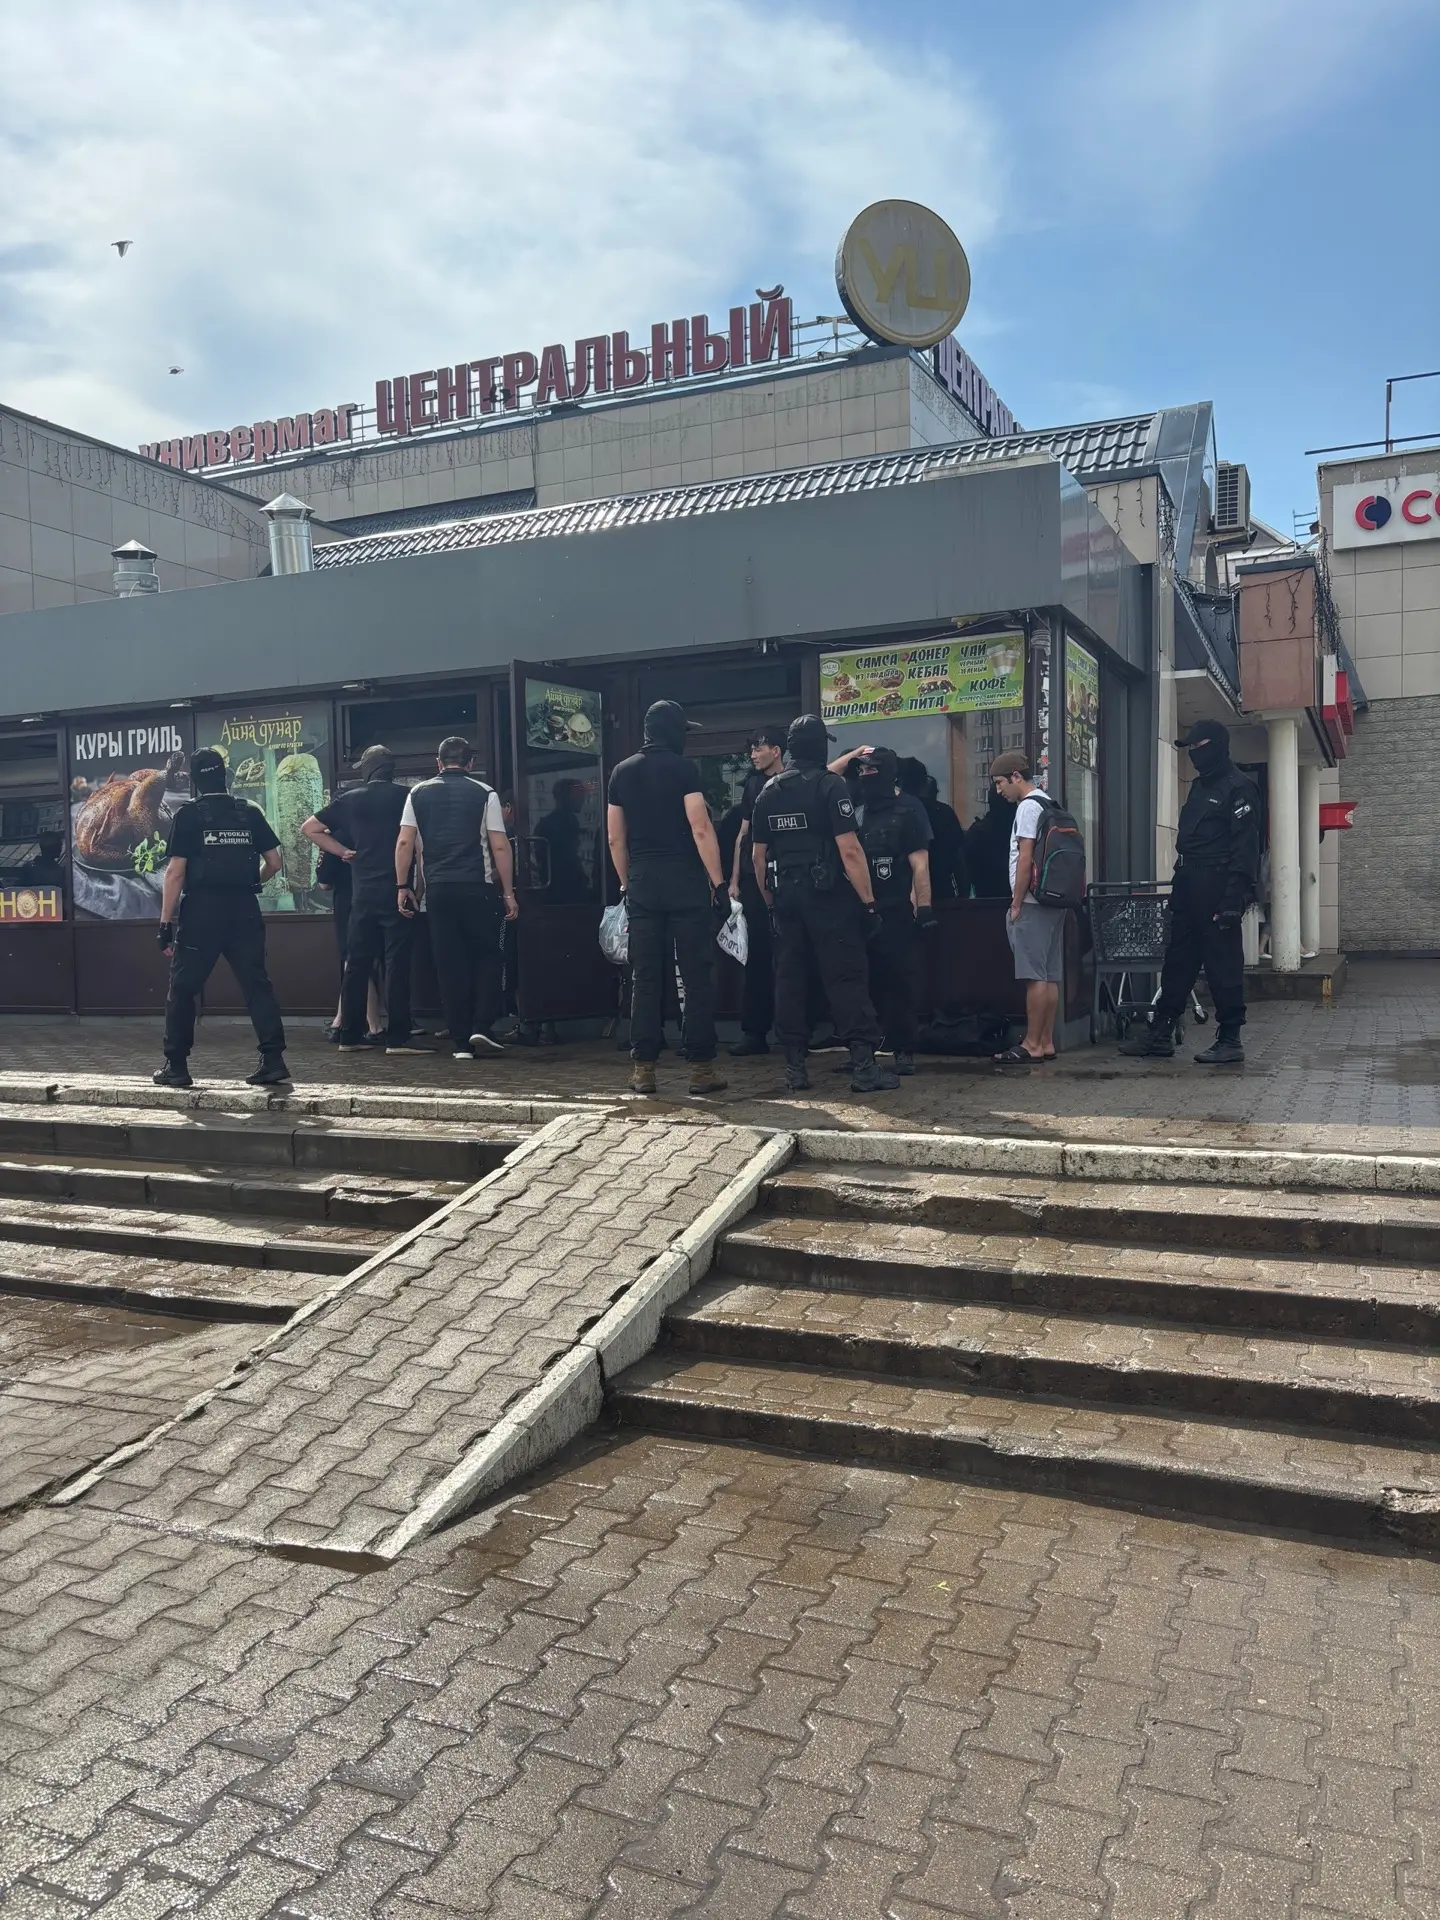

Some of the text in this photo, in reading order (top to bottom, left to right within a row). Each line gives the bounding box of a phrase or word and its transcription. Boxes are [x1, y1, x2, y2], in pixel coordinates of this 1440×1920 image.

[375, 284, 793, 437] ЦЕНТРАЛЬНЫЙ
[855, 653, 898, 669] САМСА
[907, 646, 950, 665] ДОНЕР
[960, 641, 987, 658] ЧАЙ
[908, 664, 949, 680] КЕБАБ
[969, 676, 1007, 692] КОФЕ
[823, 696, 944, 718] ШАУРМА ПИТА
[76, 725, 182, 760] КУРЫ ГРИЛЬ
[777, 816, 798, 829] ДНД
